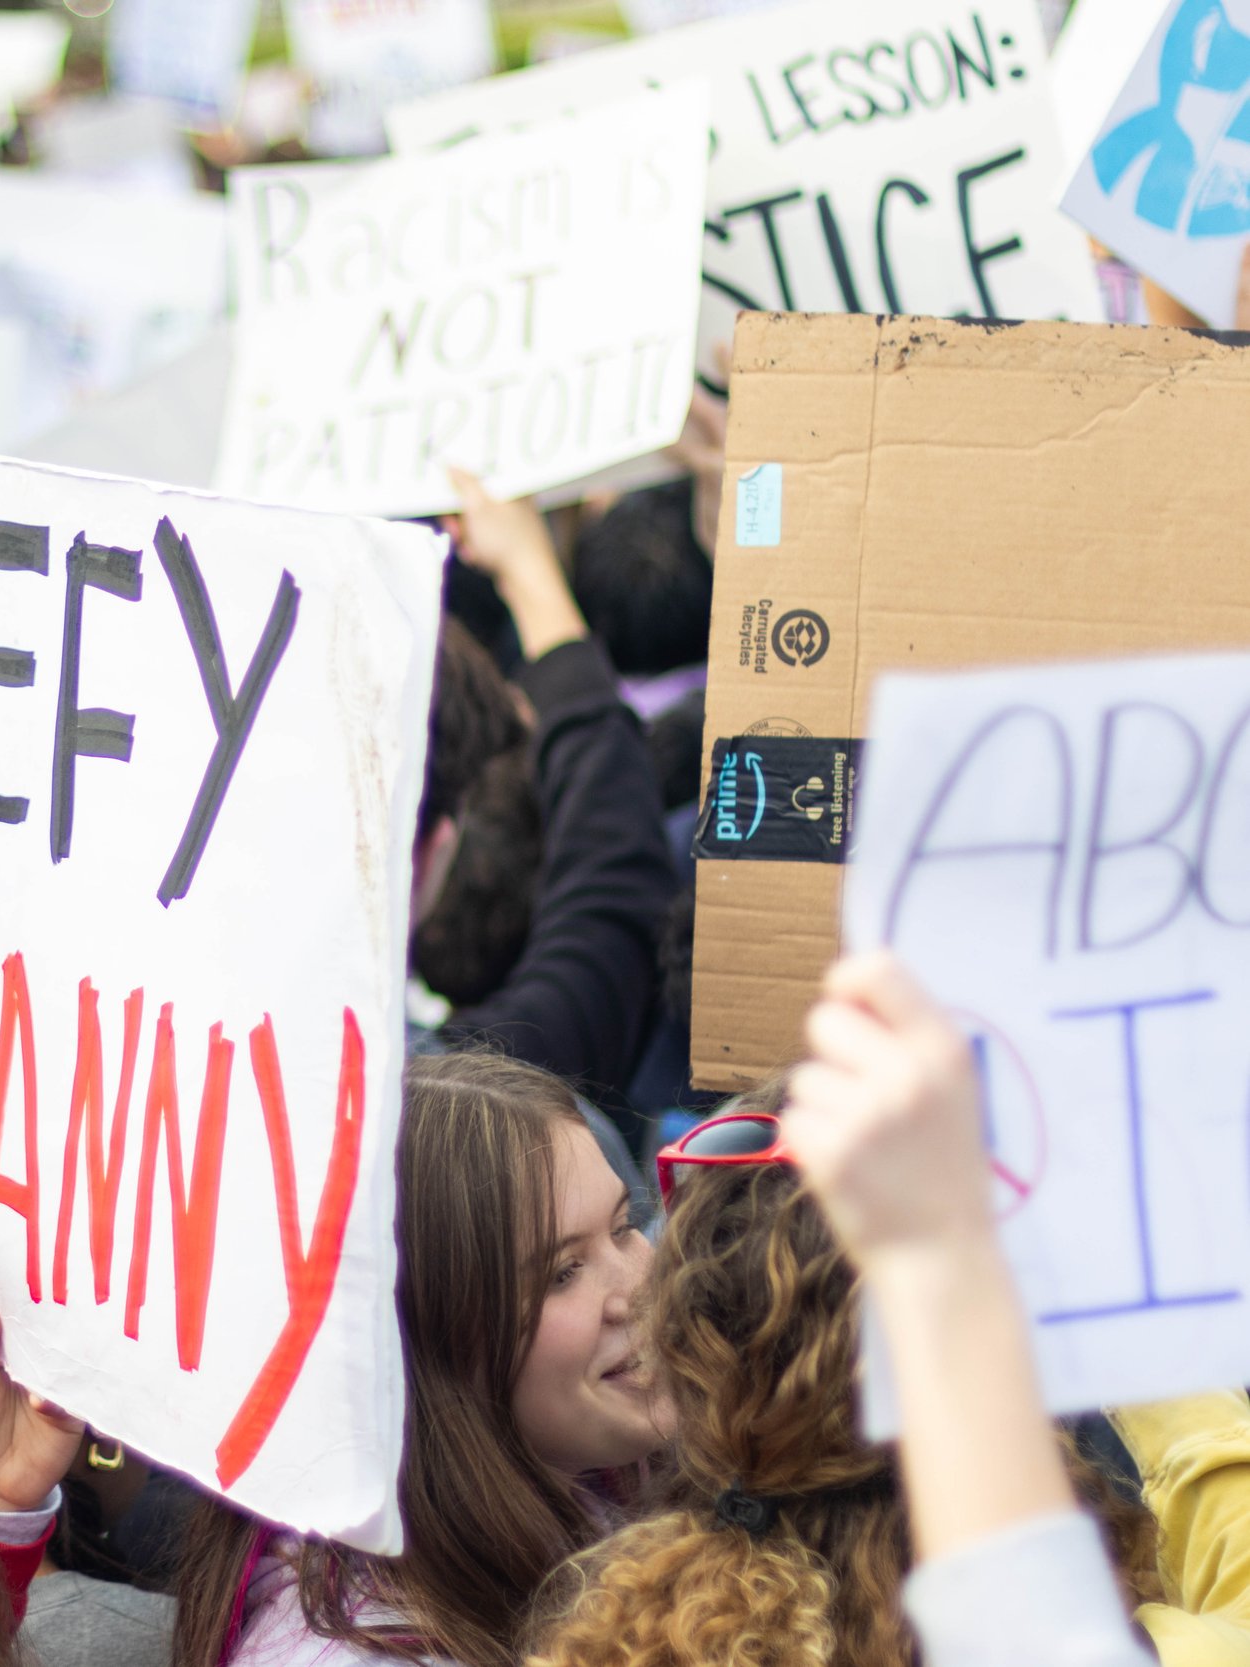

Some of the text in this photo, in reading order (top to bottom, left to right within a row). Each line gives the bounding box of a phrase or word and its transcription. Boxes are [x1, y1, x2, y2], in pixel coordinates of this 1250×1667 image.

[747, 13, 1025, 144] LESSON:
[250, 165, 572, 304] Racism
[700, 146, 1023, 397] STICE
[345, 262, 560, 393] NOT
[738, 604, 756, 667] Recycles
[753, 598, 773, 674] Corrugated
[711, 752, 743, 841] prime
[830, 752, 847, 845] free listening
